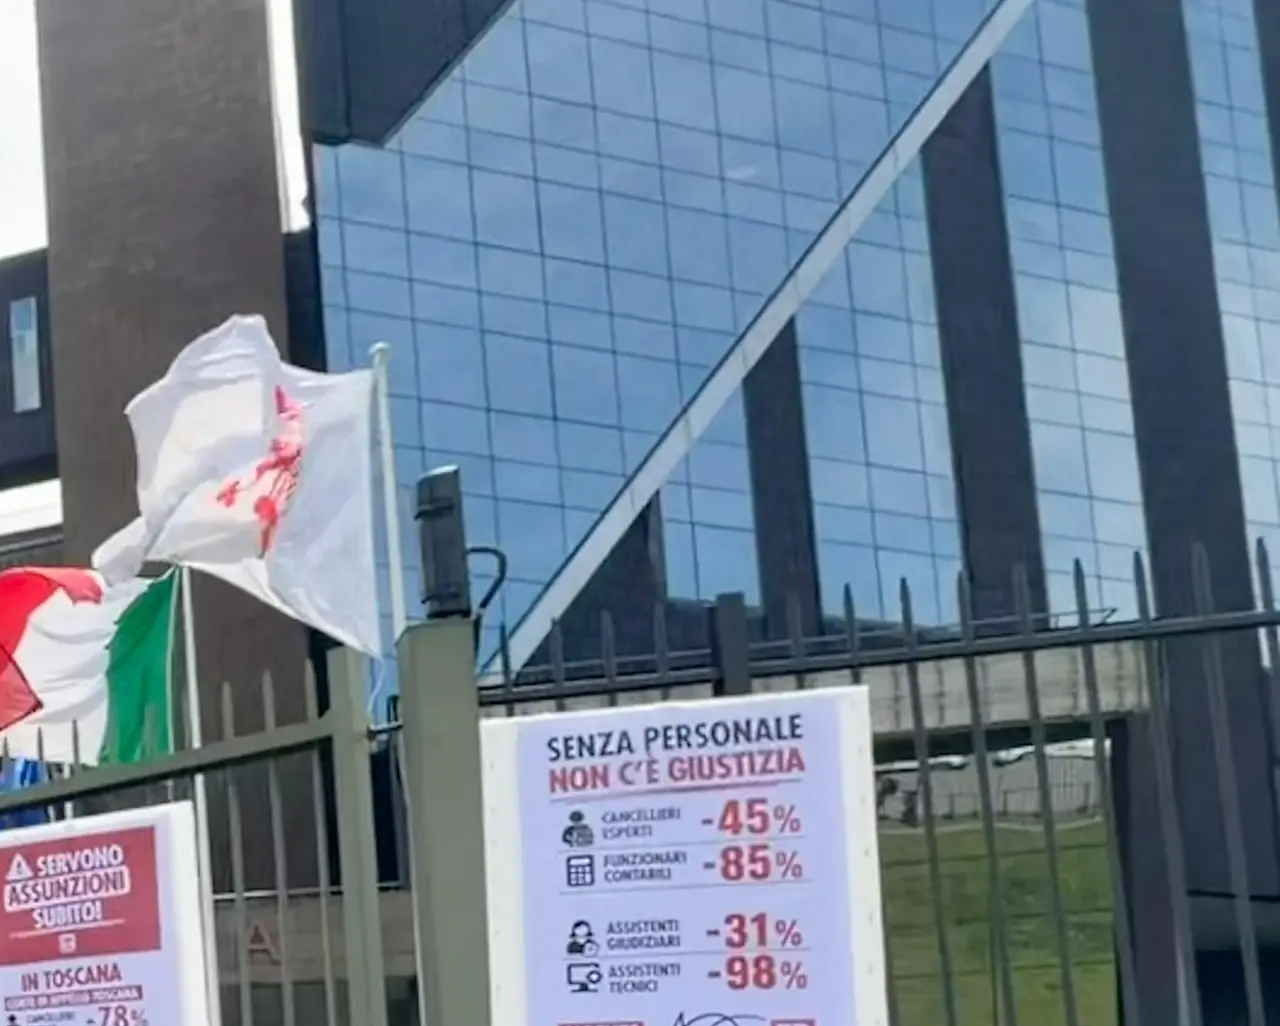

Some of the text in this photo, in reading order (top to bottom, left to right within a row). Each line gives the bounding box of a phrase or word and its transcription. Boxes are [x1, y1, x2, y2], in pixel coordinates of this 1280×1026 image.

[547, 713, 804, 762] SENZA PERSONALE
[549, 764, 610, 794] NON
[667, 746, 806, 782] GIUSTIZIA
[37, 844, 124, 877] SERVONO
[8, 870, 126, 906] ASSUNZIONI
[32, 900, 102, 929] SUBITO!
[607, 919, 680, 935] ASSISTENTI
[607, 935, 681, 951] GIUDIZIARI
[21, 963, 122, 992] IN TOSCANA
[608, 963, 681, 979] ASSISTENTI
